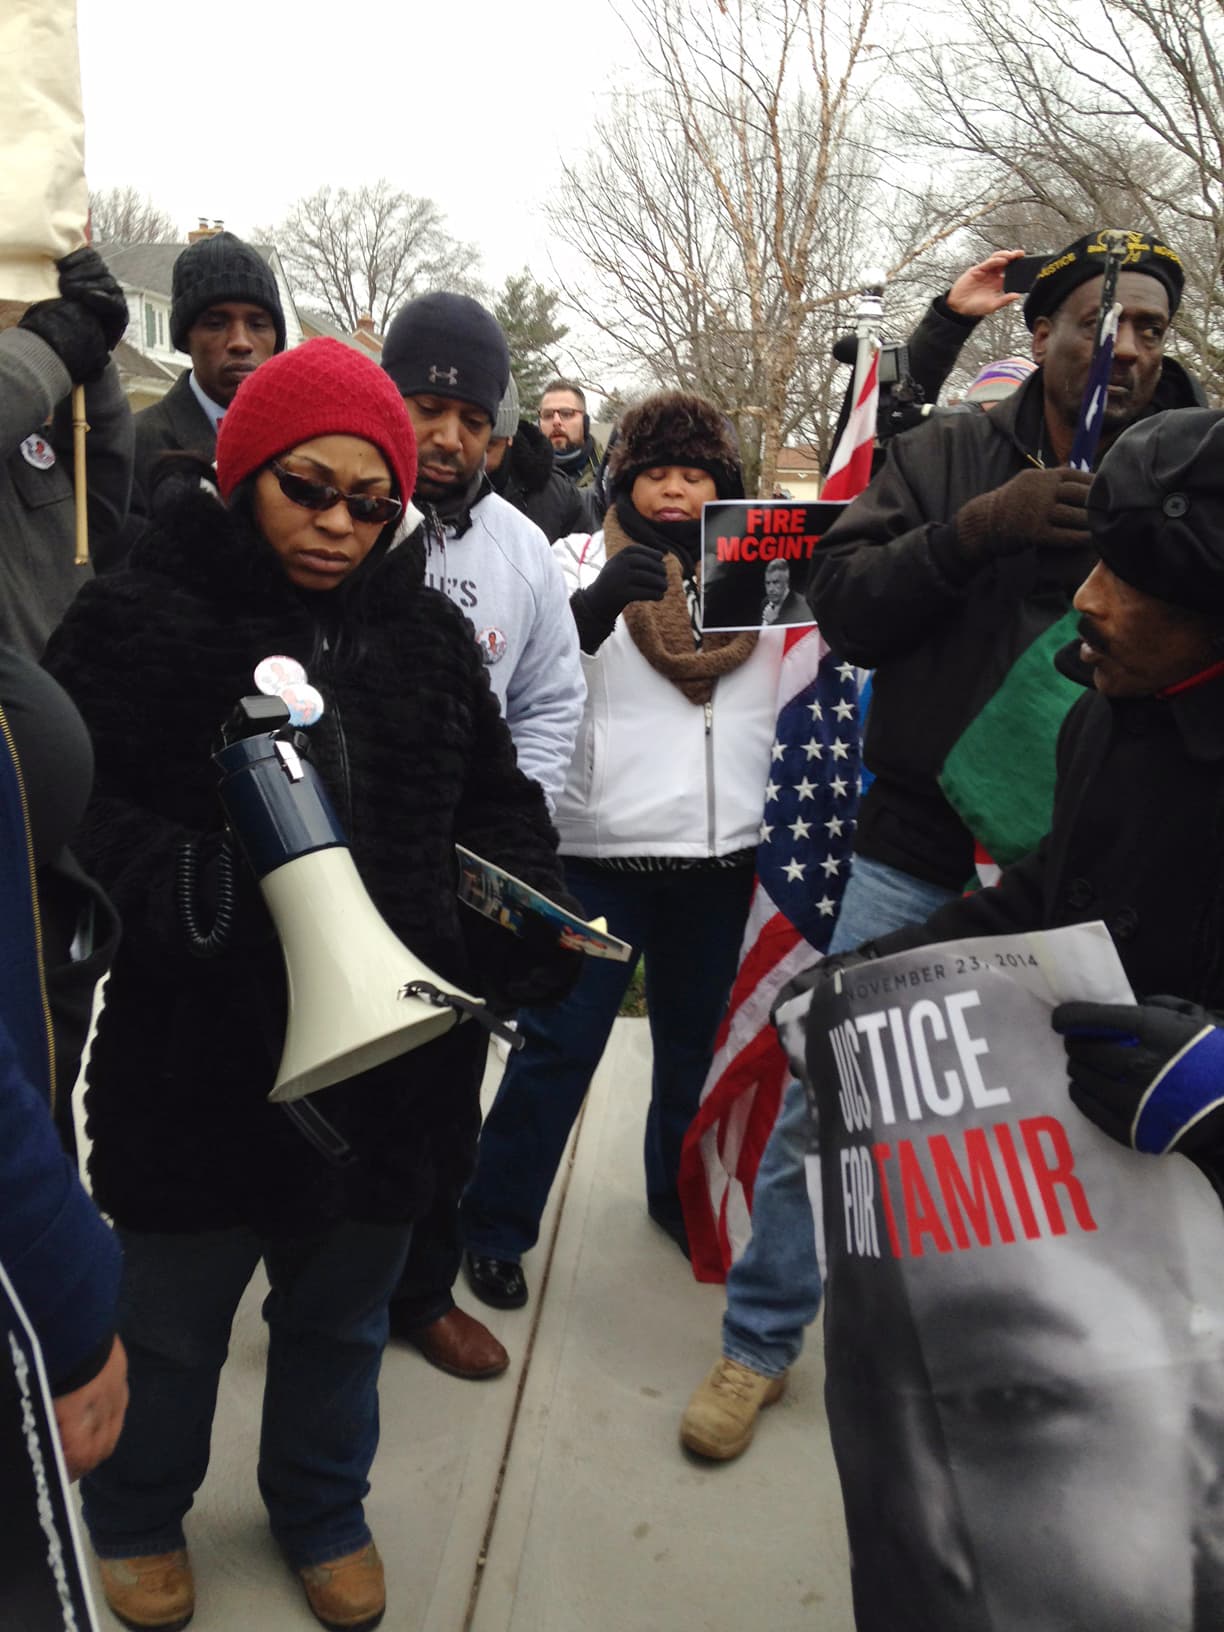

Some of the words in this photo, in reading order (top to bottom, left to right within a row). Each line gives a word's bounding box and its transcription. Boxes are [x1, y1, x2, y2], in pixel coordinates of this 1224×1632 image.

[746, 508, 808, 535] FIRE
[716, 535, 822, 562] MCGINT
[846, 964, 946, 1001] NOVEMBER
[955, 956, 990, 974] 23,
[995, 953, 1039, 968] 2014
[828, 989, 1011, 1134] JUSTICE
[840, 1145, 881, 1259] FOR
[873, 1115, 1099, 1259] TAMIR
